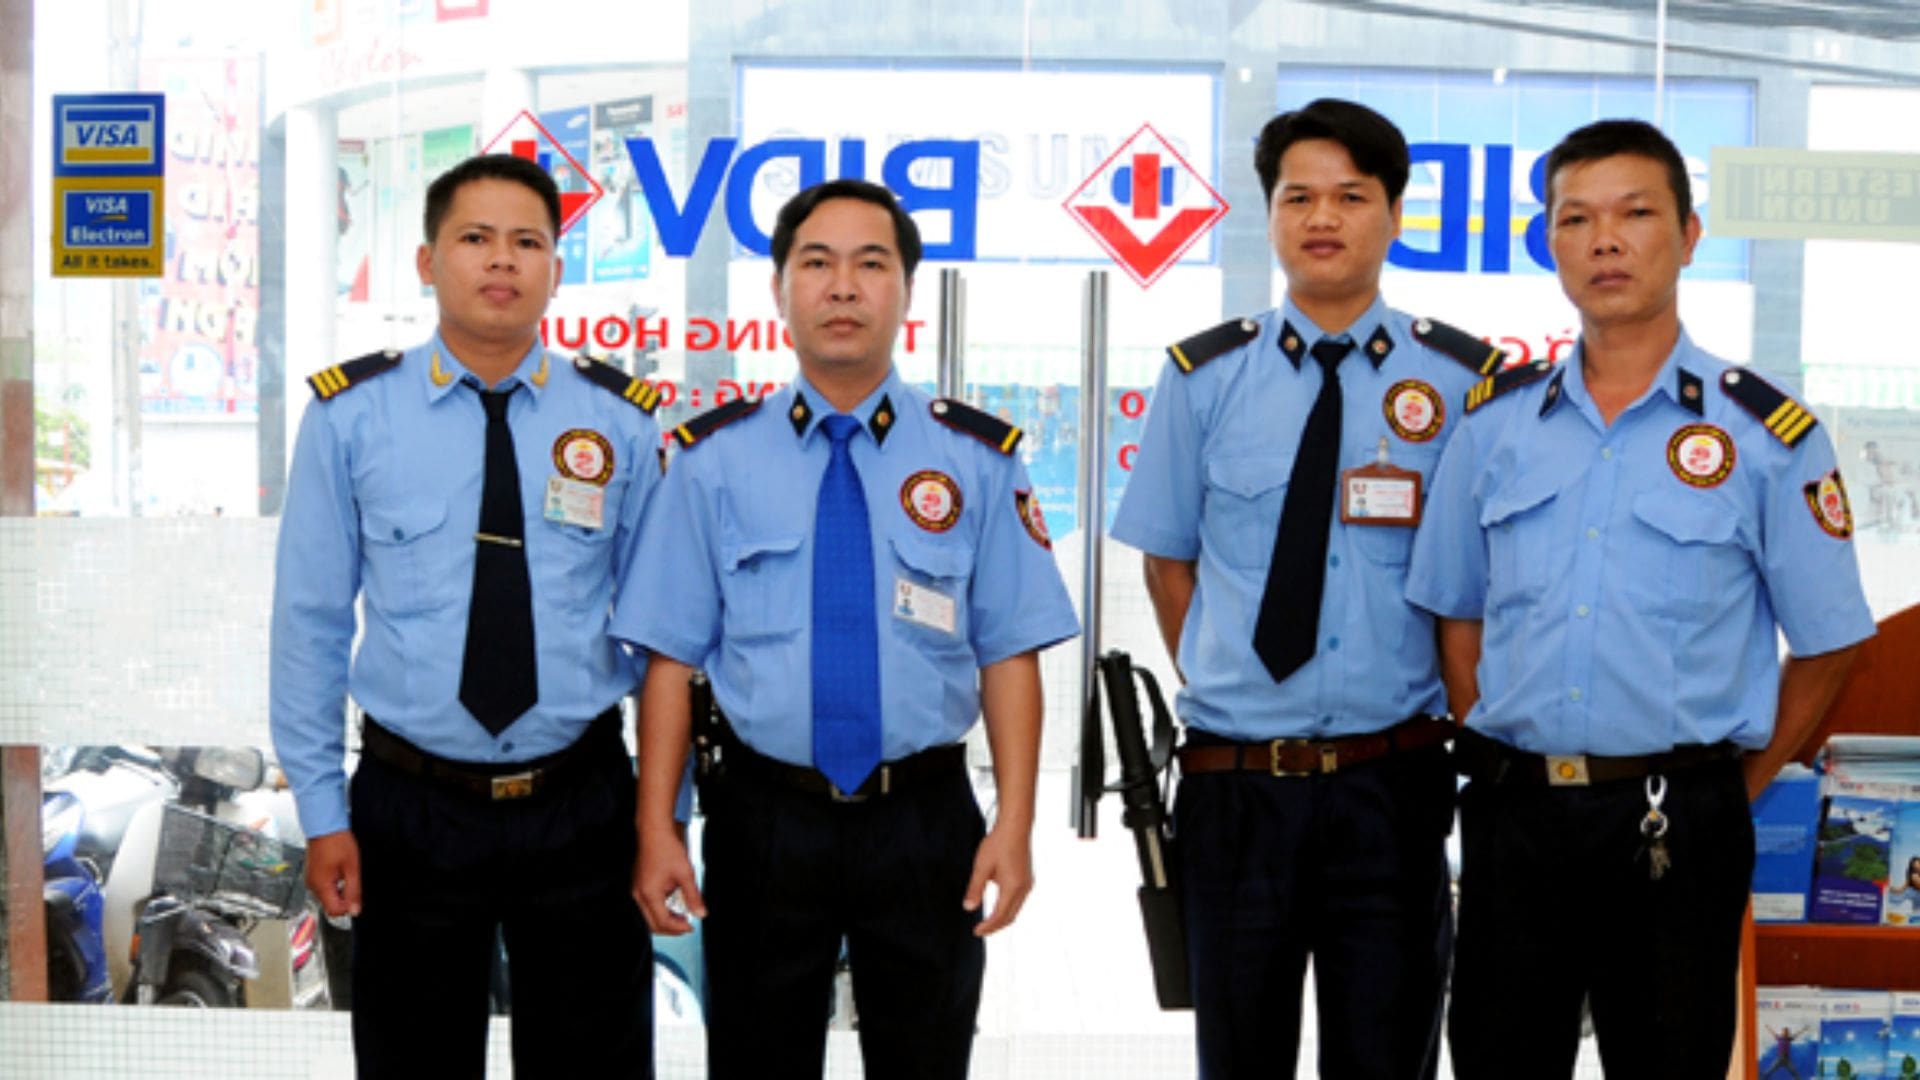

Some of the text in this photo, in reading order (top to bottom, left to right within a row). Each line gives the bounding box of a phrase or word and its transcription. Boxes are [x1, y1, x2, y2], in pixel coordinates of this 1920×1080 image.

[75, 123, 139, 147] VISA
[85, 196, 128, 214] VISA
[71, 225, 146, 244] Electron
[62, 254, 82, 268] All
[88, 254, 100, 268] it
